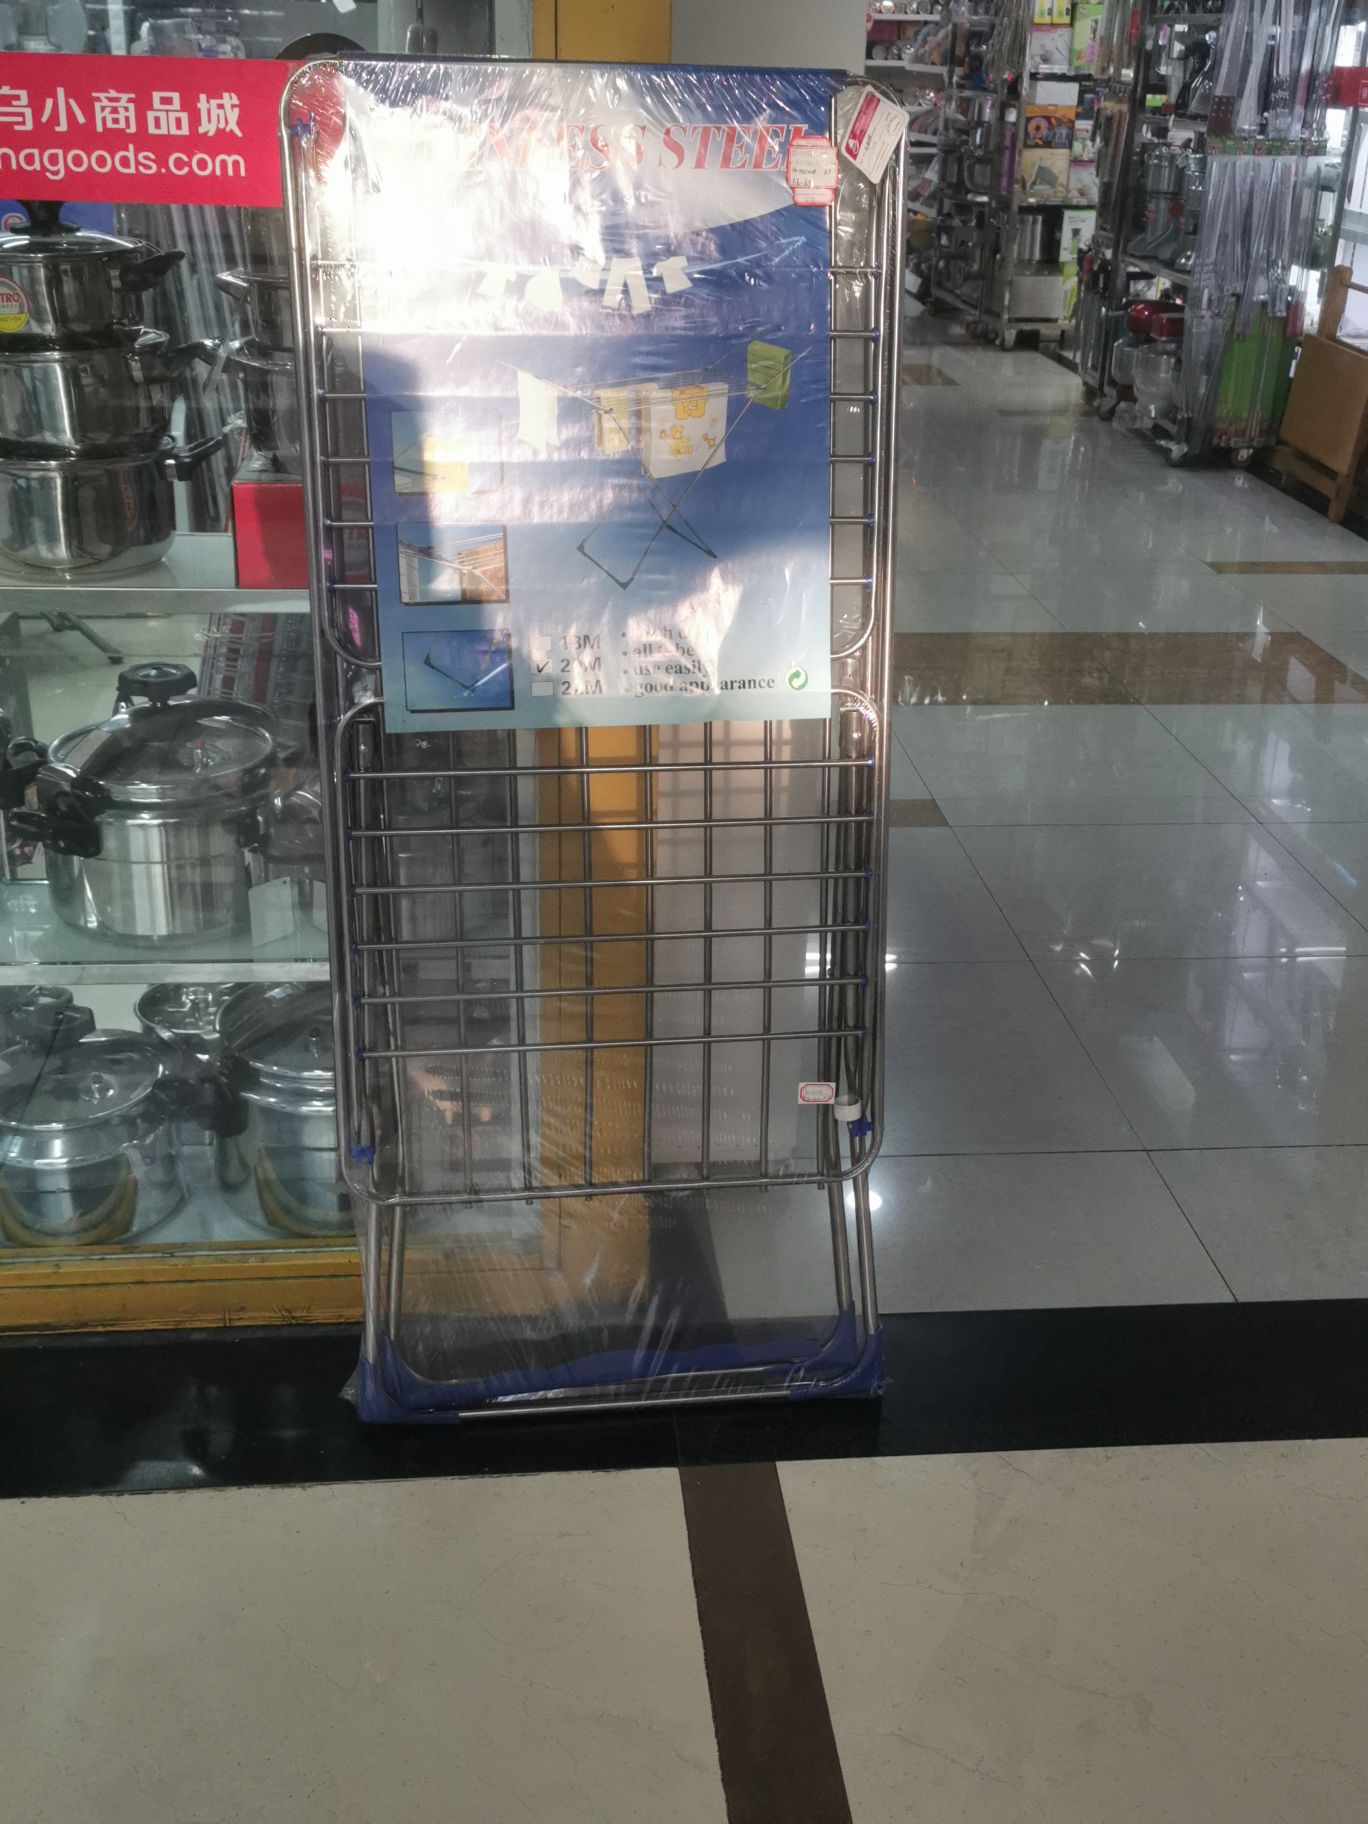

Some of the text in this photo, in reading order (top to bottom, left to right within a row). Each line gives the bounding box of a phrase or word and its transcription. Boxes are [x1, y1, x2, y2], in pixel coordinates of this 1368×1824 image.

[0, 86, 243, 138] 乌小商品城
[560, 656, 602, 673] 2M
[560, 679, 603, 696] 2M
